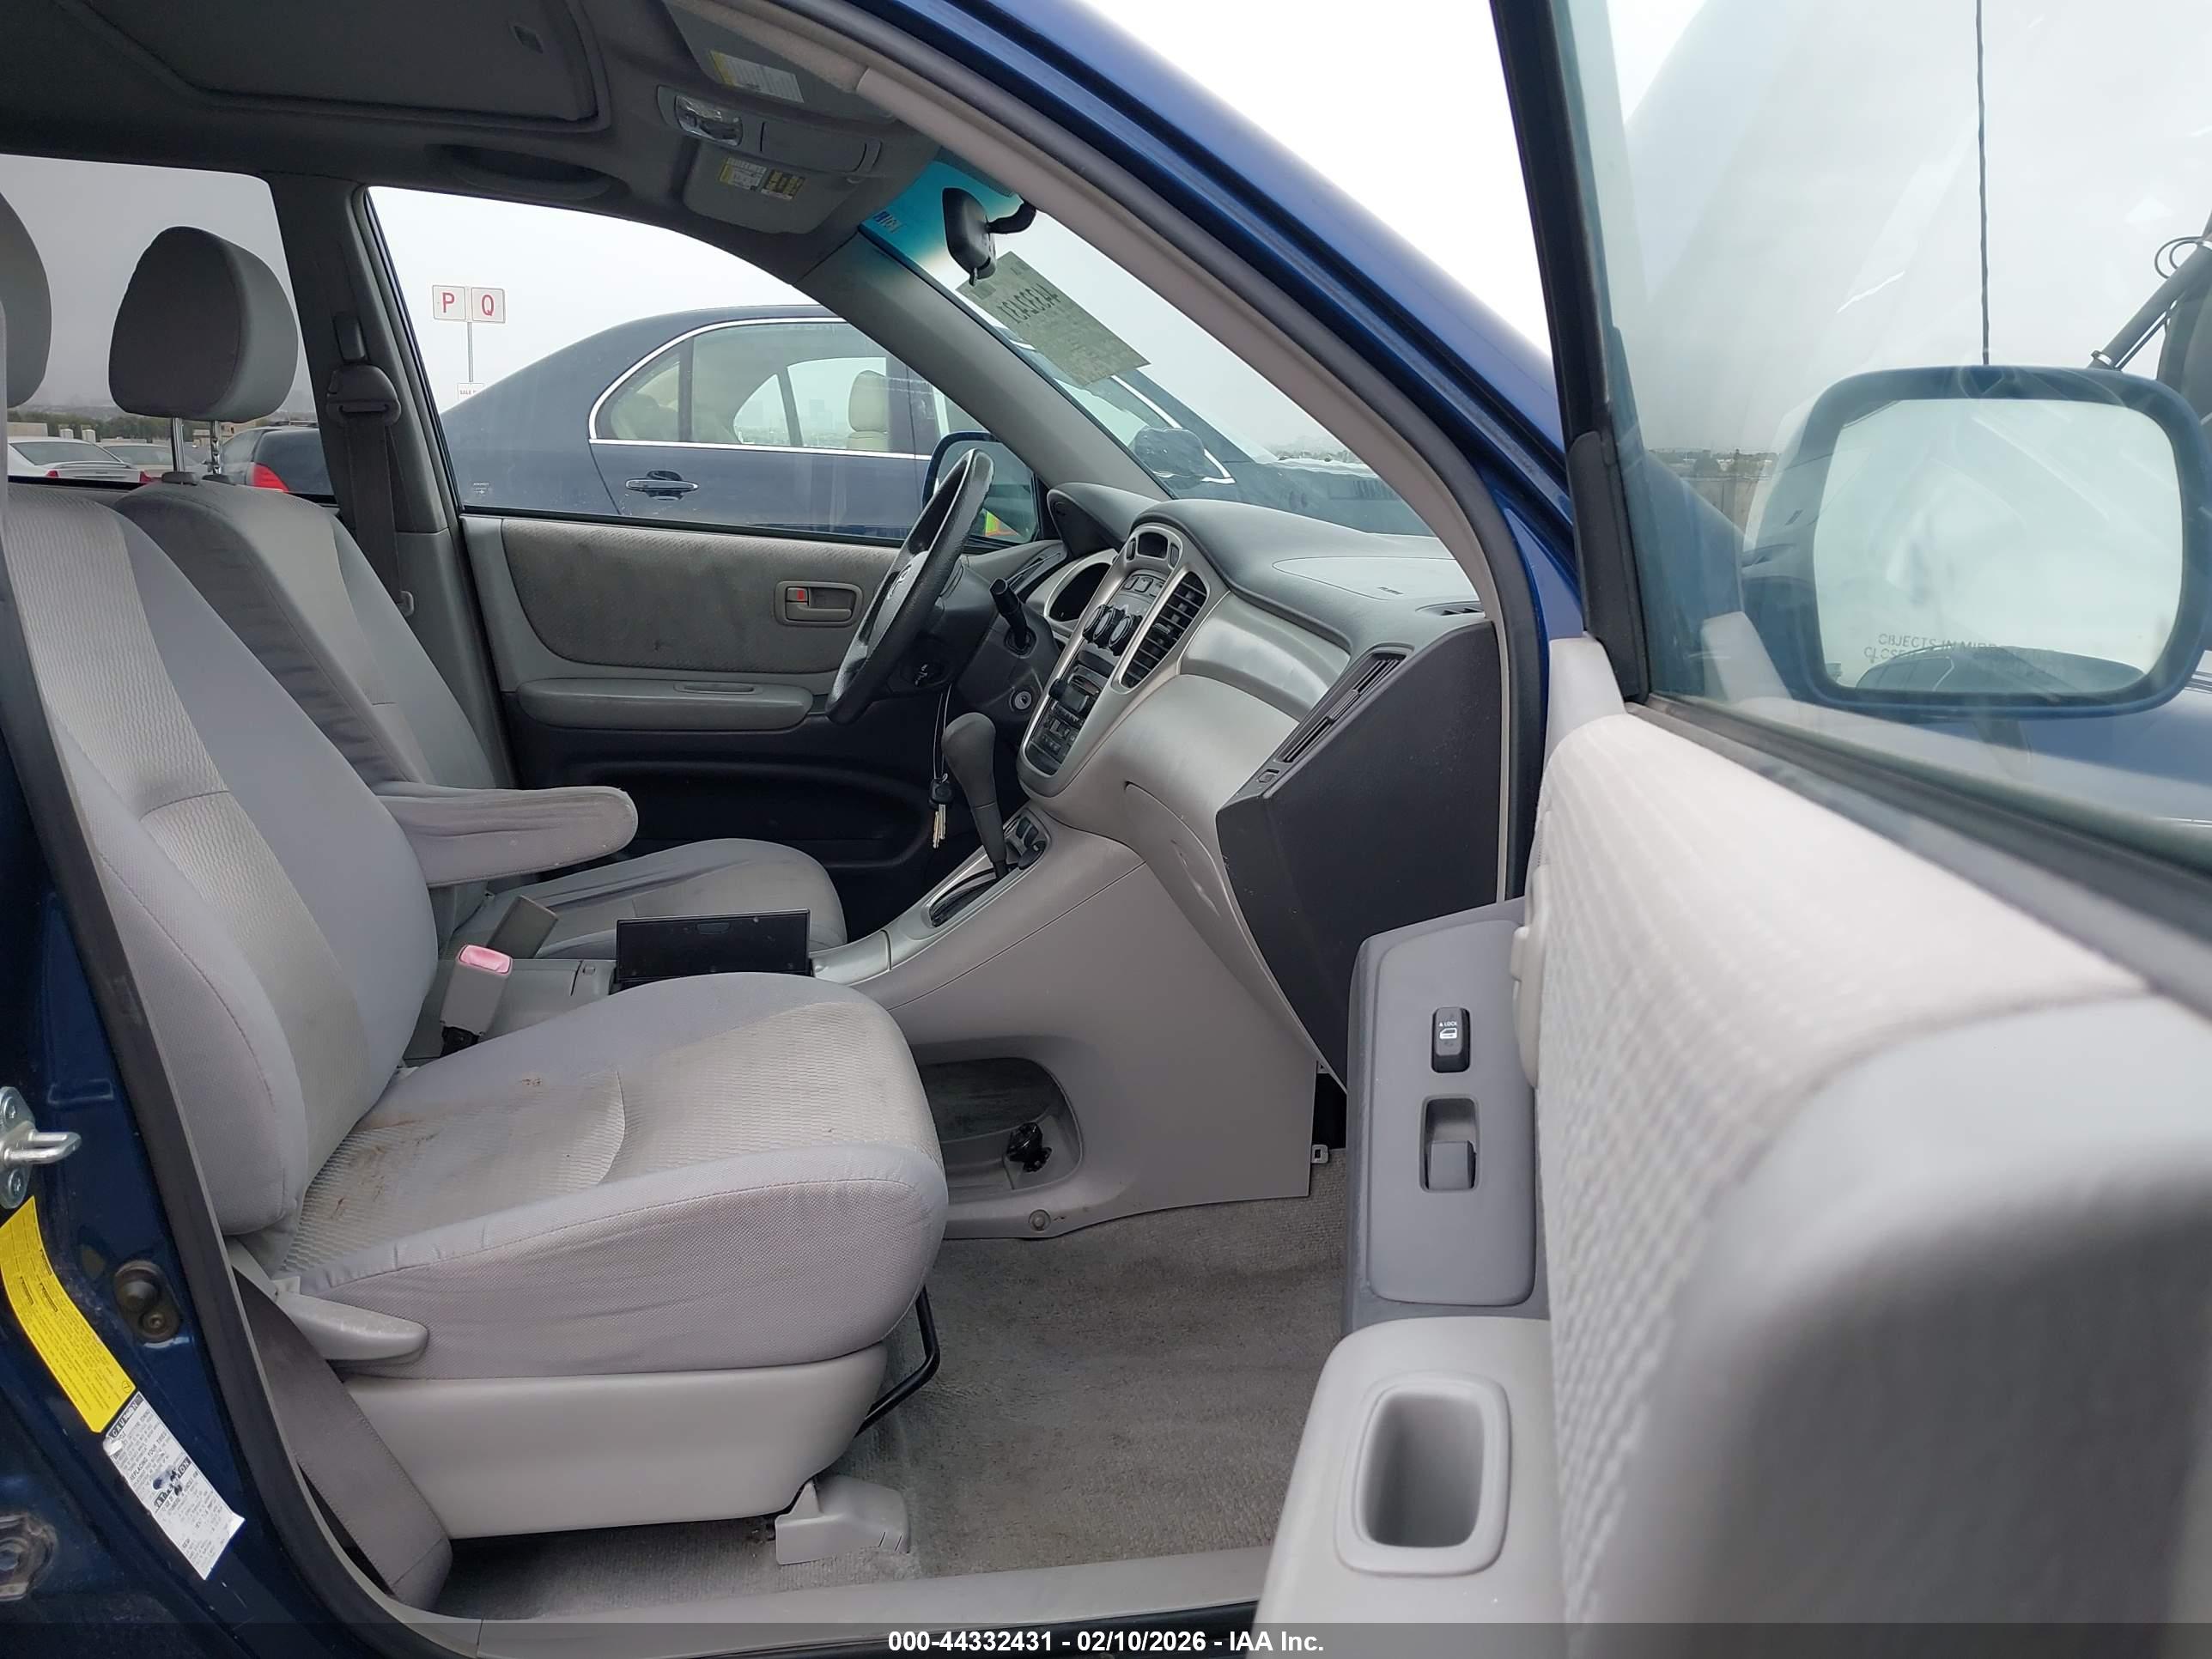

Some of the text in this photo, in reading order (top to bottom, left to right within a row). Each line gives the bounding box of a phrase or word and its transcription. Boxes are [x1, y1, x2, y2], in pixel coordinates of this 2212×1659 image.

[442, 292, 455, 313] P
[481, 295, 495, 316] Q
[1878, 633, 1936, 648] OBJECTS
